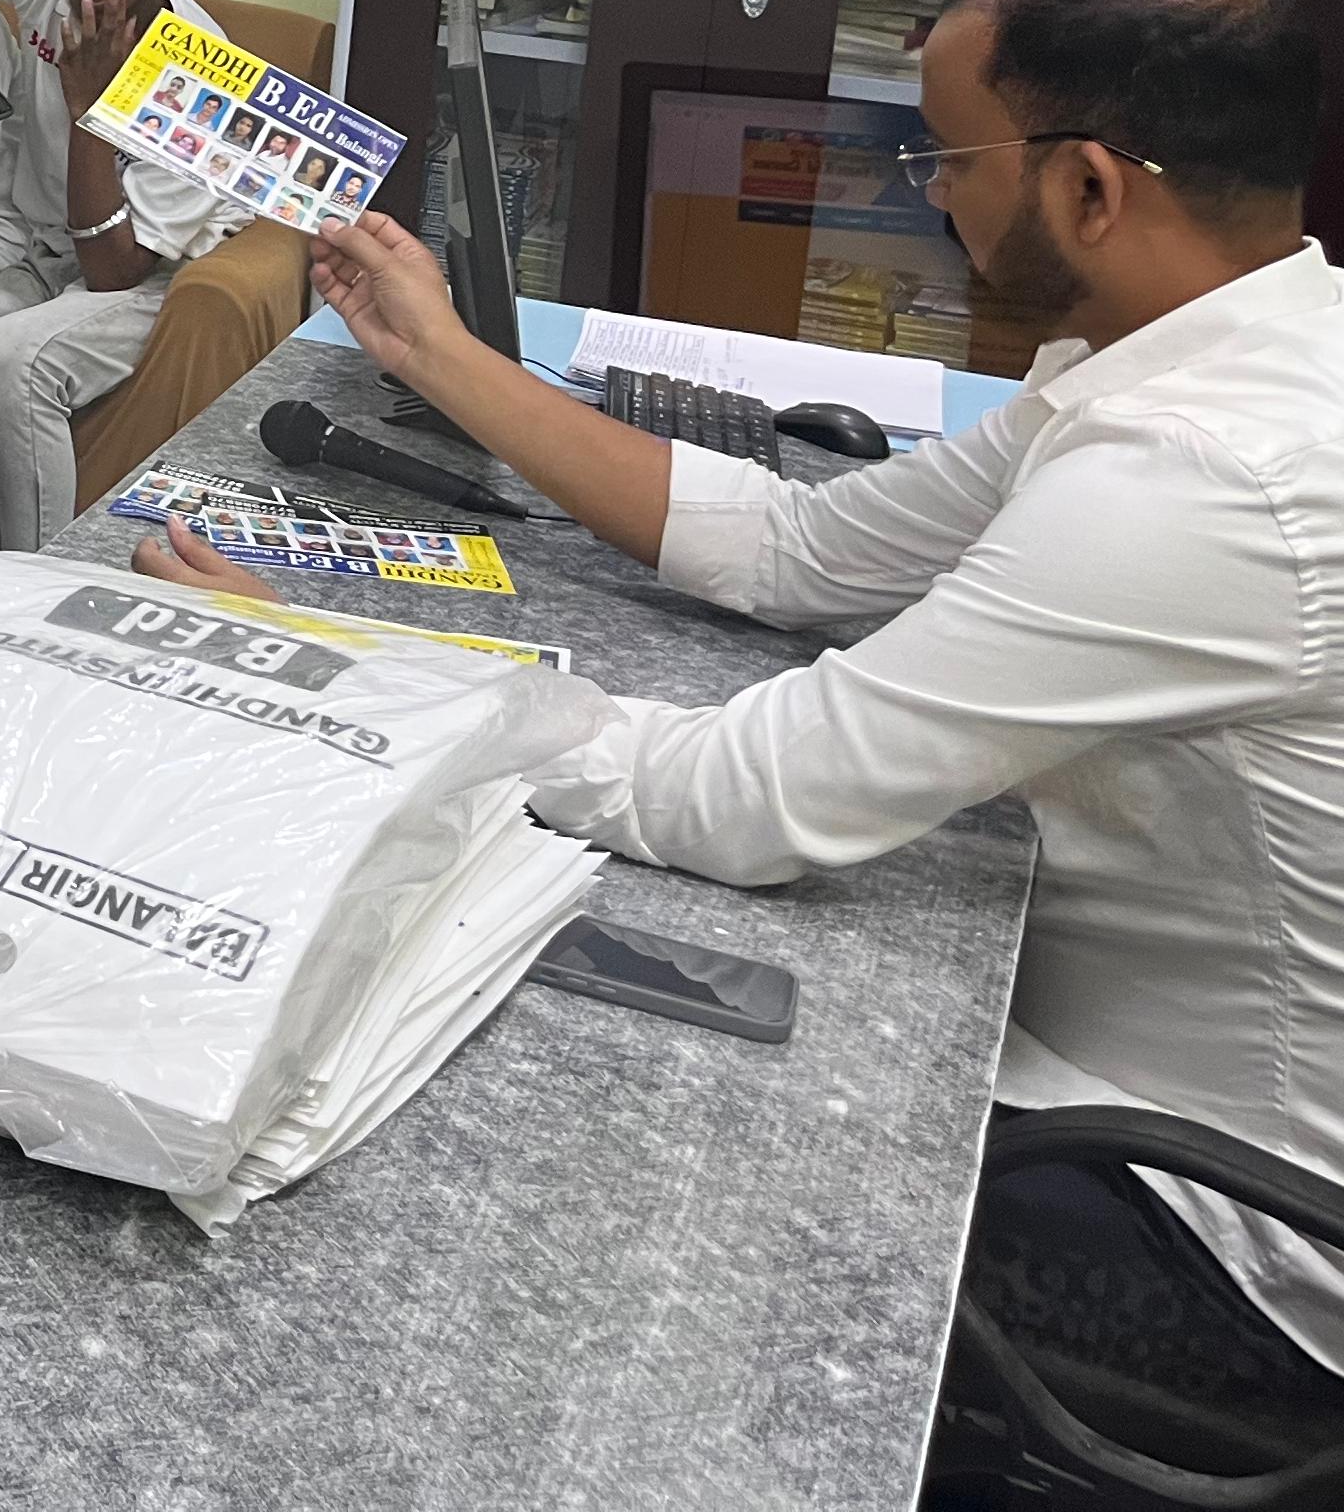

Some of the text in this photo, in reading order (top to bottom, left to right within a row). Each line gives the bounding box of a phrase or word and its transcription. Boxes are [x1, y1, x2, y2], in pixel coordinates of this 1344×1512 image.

[150, 40, 246, 96] INSTITUTE
[160, 21, 260, 85] GANDHI
[256, 75, 336, 140] B.Ed.
[335, 131, 388, 168] Balangir
[385, 565, 503, 590] GANDHI
[113, 595, 304, 675] B.Ed.
[187, 683, 391, 755] GANDHI
